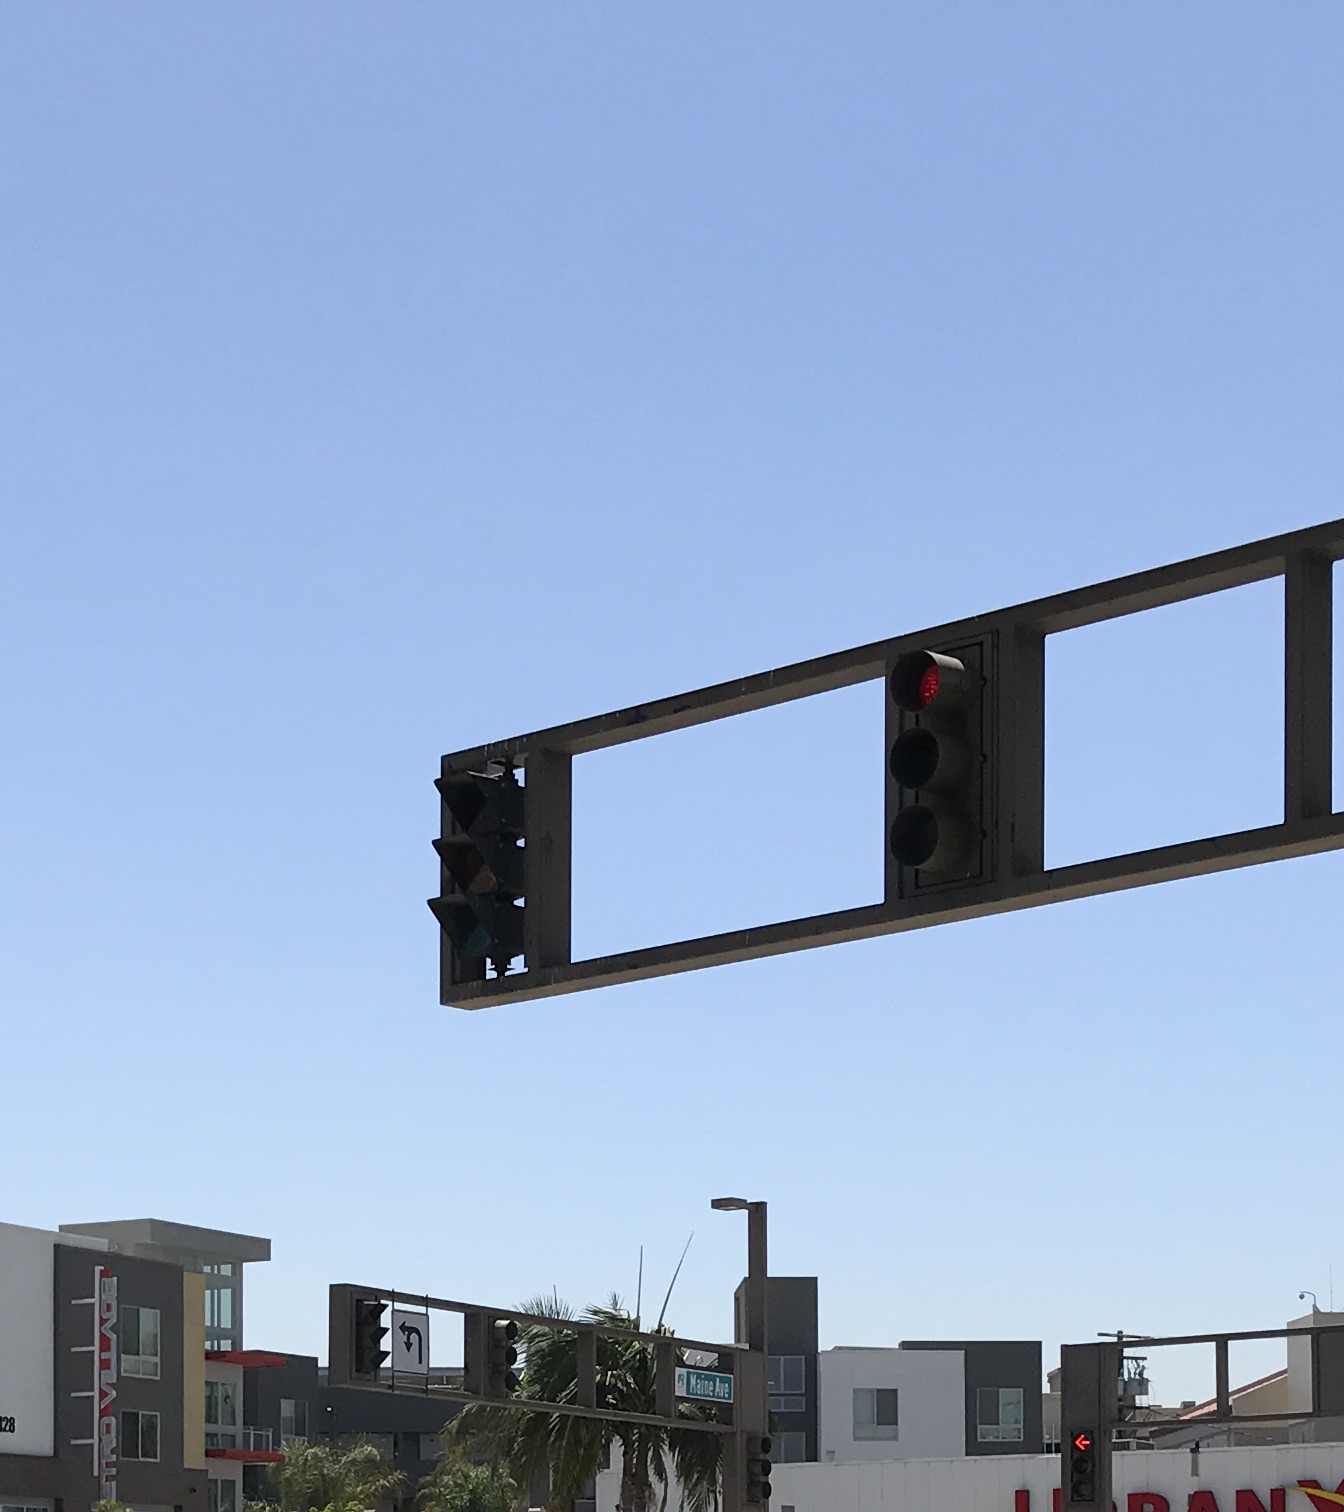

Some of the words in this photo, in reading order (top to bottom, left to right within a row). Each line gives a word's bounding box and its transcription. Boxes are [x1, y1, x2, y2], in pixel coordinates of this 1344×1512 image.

[100, 1276, 117, 1409] VILLAGE
[690, 1374, 714, 1396] Maine
[715, 1378, 729, 1398] Ave
[100, 1416, 117, 1501] ETRO
